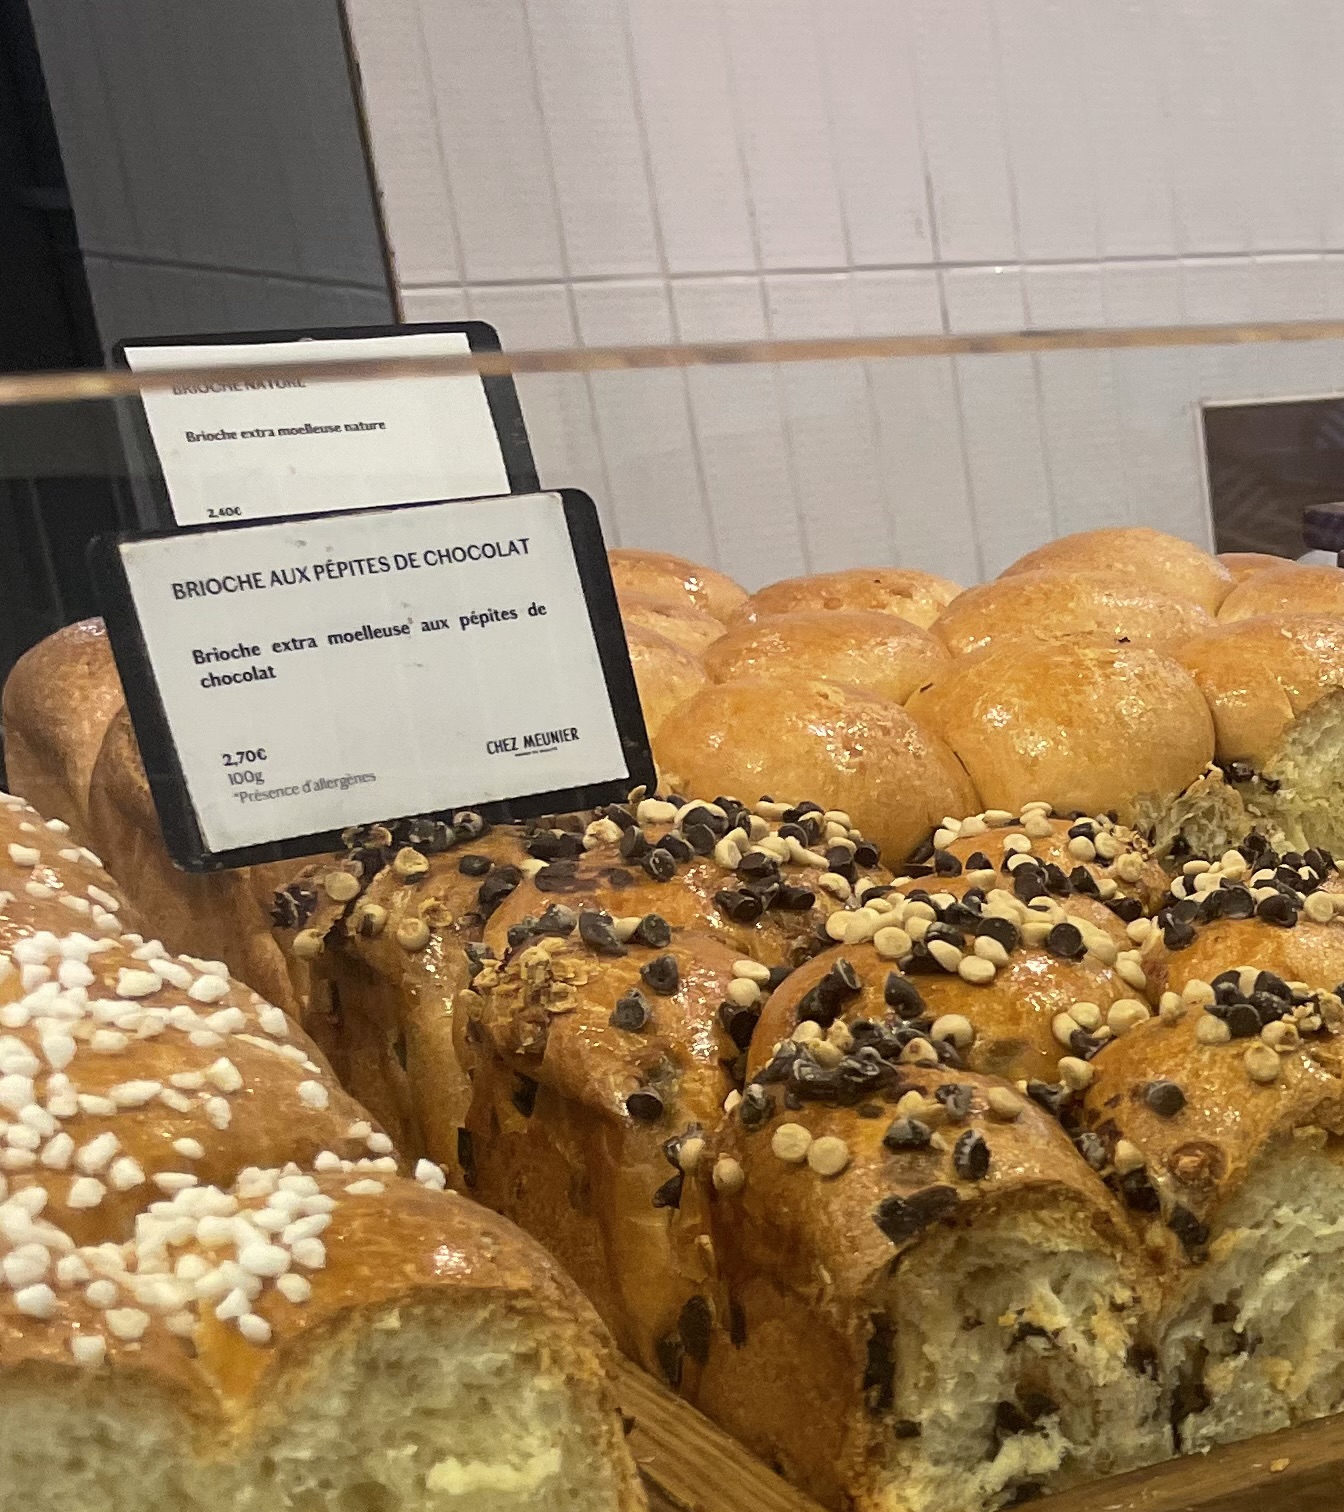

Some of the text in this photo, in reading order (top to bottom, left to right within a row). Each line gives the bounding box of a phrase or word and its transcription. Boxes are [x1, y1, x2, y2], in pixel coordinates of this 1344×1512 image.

[185, 421, 387, 443] Brioche extra moelleuse nature
[171, 538, 530, 600] BRIOCHE AUX PÉPITES DE CHOCOLAT
[192, 602, 548, 665] Brioche extra moelleuse aux pépites de
[200, 665, 277, 689] chocolat
[486, 727, 580, 755] CHEZ MEUNIER
[222, 748, 268, 767] 2,70€
[227, 770, 265, 786] 100g
[302, 772, 377, 793] d'allergènes
